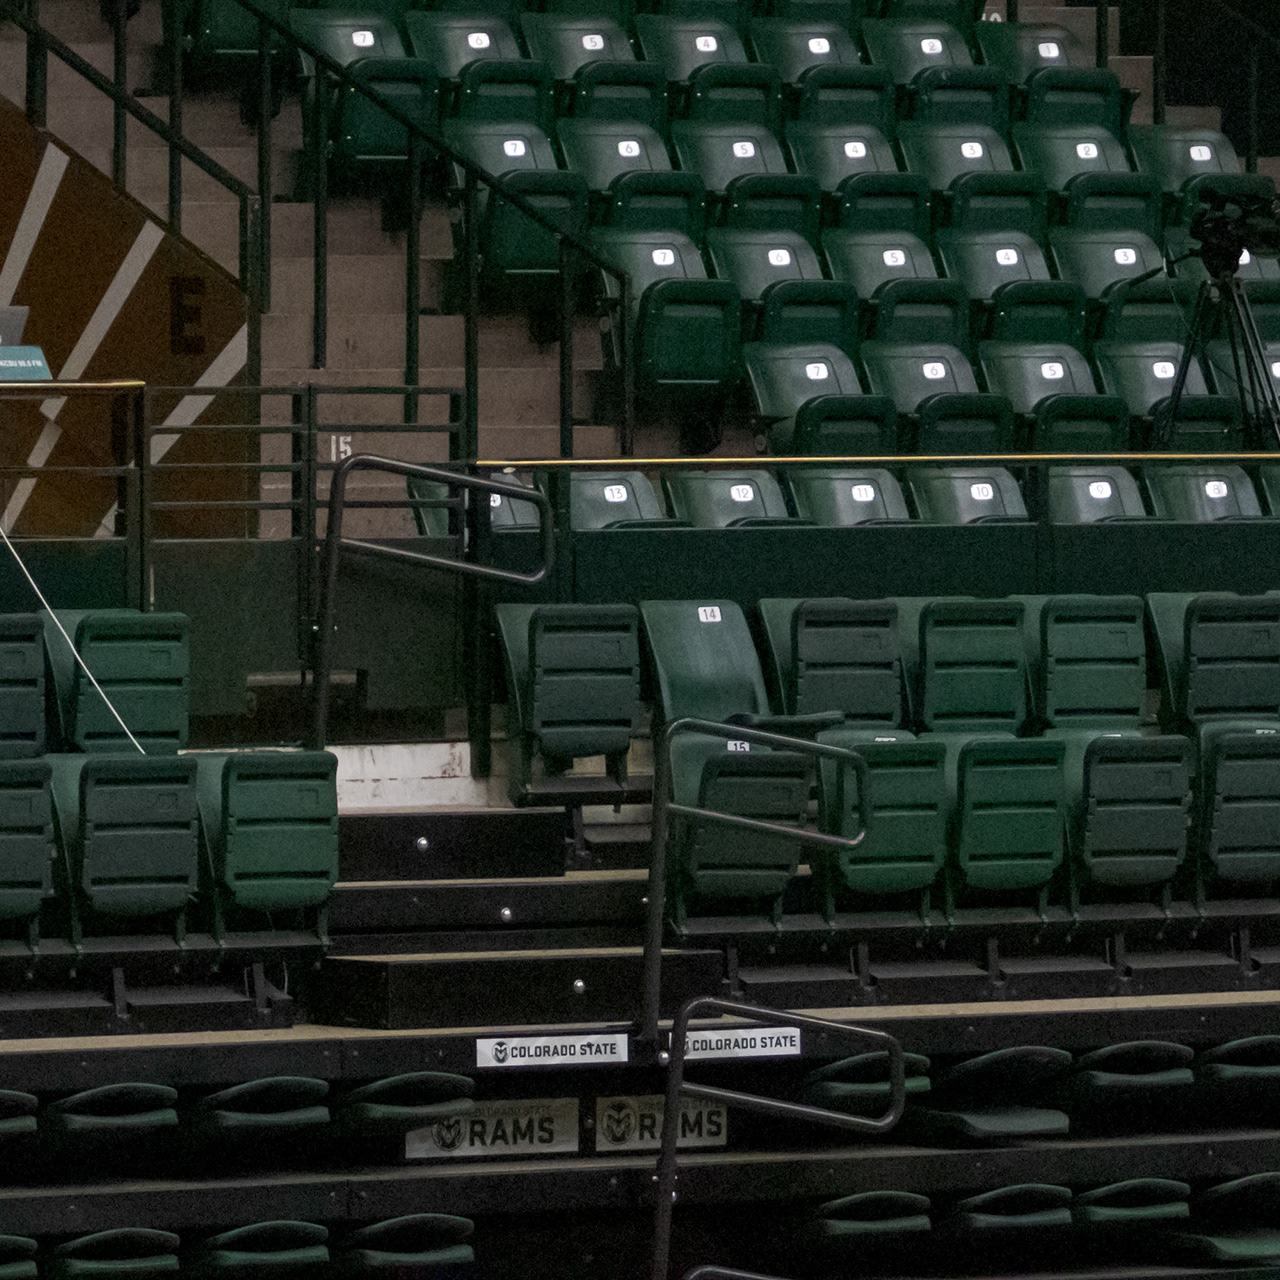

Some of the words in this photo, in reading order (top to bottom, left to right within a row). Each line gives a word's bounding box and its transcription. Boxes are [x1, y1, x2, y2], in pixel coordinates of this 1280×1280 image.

[170, 277, 205, 354] E
[330, 435, 352, 461] 15
[609, 488, 623, 499] 13
[736, 488, 749, 499] 12
[857, 487, 869, 498] 11
[976, 486, 990, 498] 10
[703, 608, 716, 620] 14
[733, 742, 746, 751] 15
[510, 1044, 577, 1059] COLORADO
[580, 1042, 617, 1056] STATE
[692, 1037, 757, 1052] COLORADO
[760, 1035, 797, 1049] STATE
[470, 1116, 555, 1147] RAMS
[638, 1110, 722, 1141] RMS
